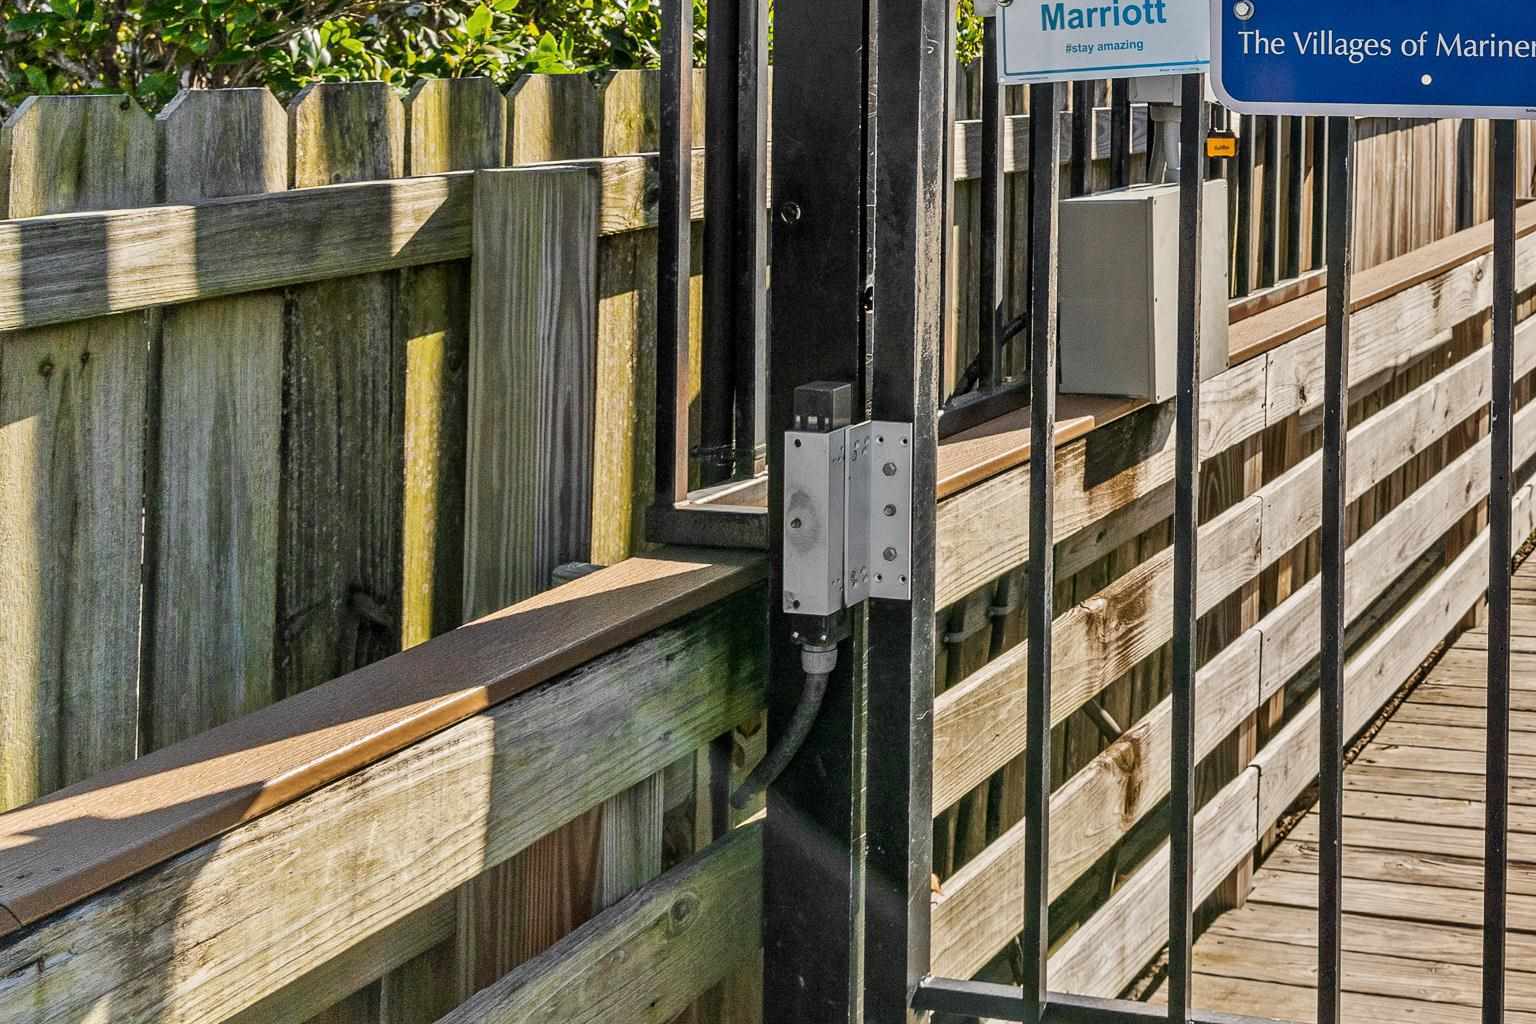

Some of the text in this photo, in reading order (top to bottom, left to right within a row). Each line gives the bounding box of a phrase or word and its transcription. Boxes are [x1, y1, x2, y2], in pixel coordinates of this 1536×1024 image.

[1065, 39, 1144, 55] #stay amazing
[1237, 29, 1285, 56] The
[1293, 30, 1392, 64] Villages
[1400, 31, 1429, 57] of
